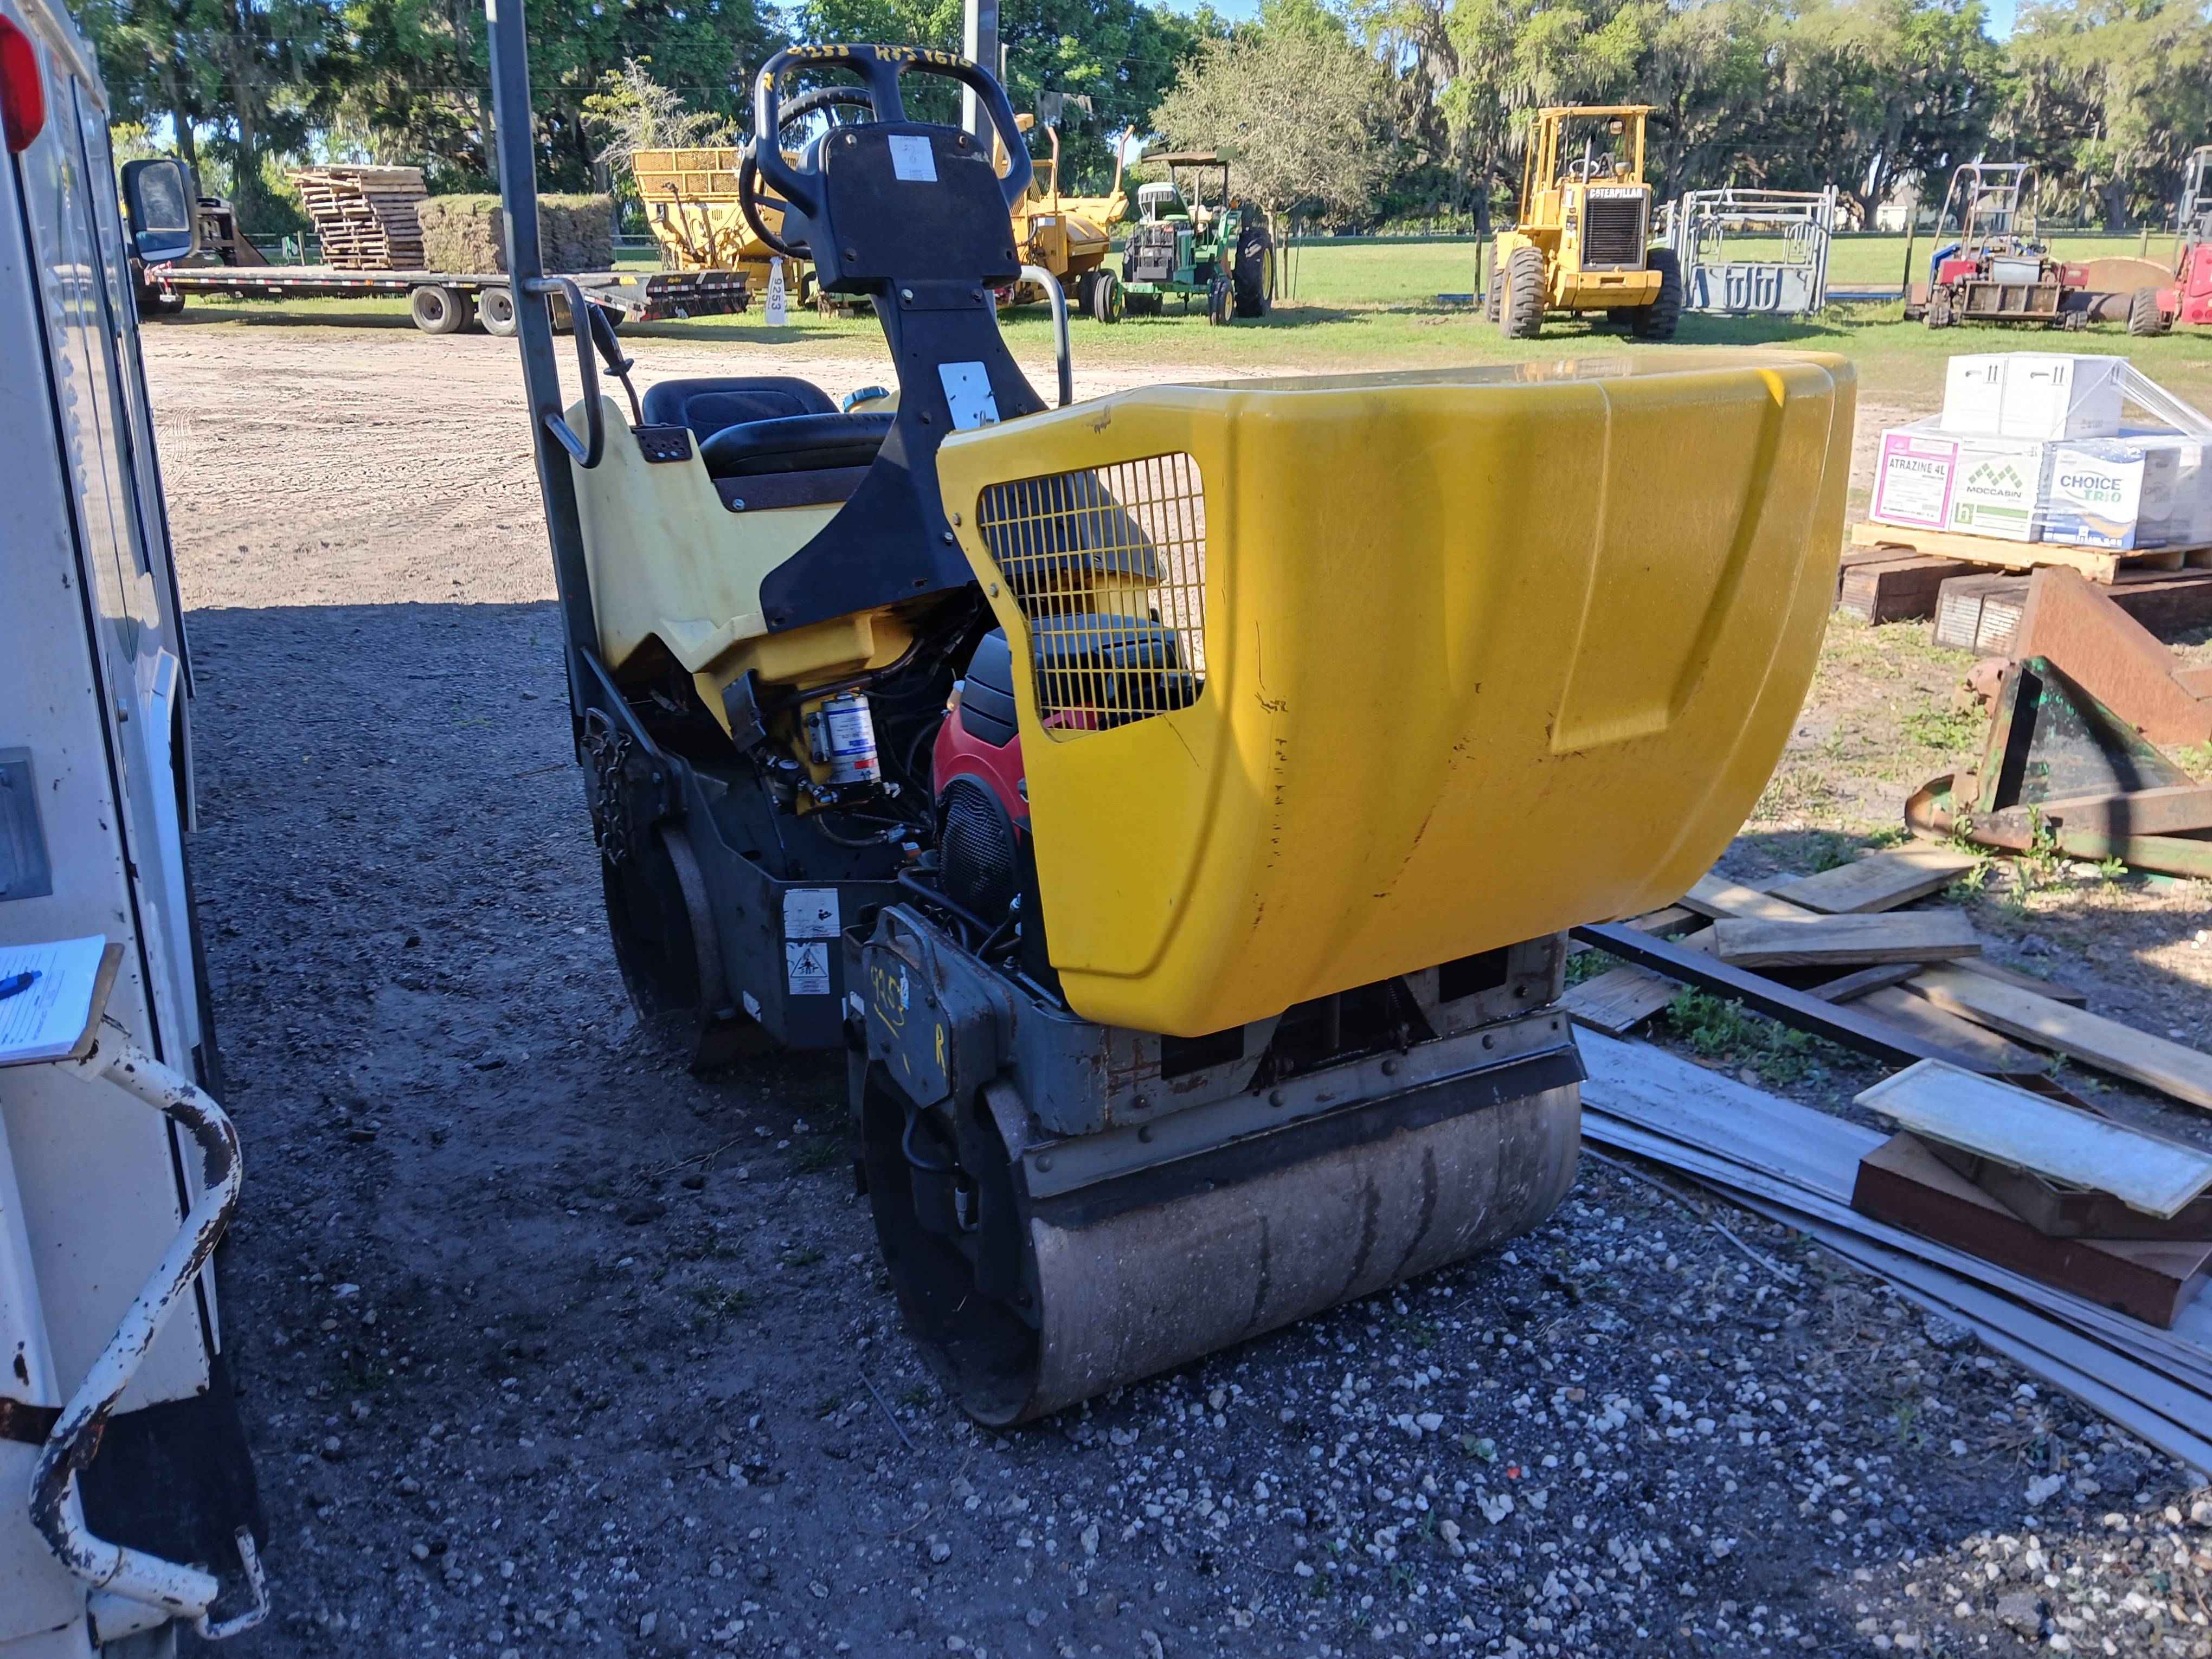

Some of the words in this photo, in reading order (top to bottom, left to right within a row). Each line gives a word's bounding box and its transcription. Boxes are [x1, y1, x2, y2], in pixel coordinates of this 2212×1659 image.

[1590, 188, 1643, 198] CATERPILLAR
[771, 278, 782, 310] 9253
[1889, 458, 1933, 473] ATRAZINE
[1934, 465, 1945, 475] 4L
[2060, 475, 2121, 491] CHOICE
[1966, 486, 2022, 498] MOCCASIN
[935, 1023, 947, 1077] R
